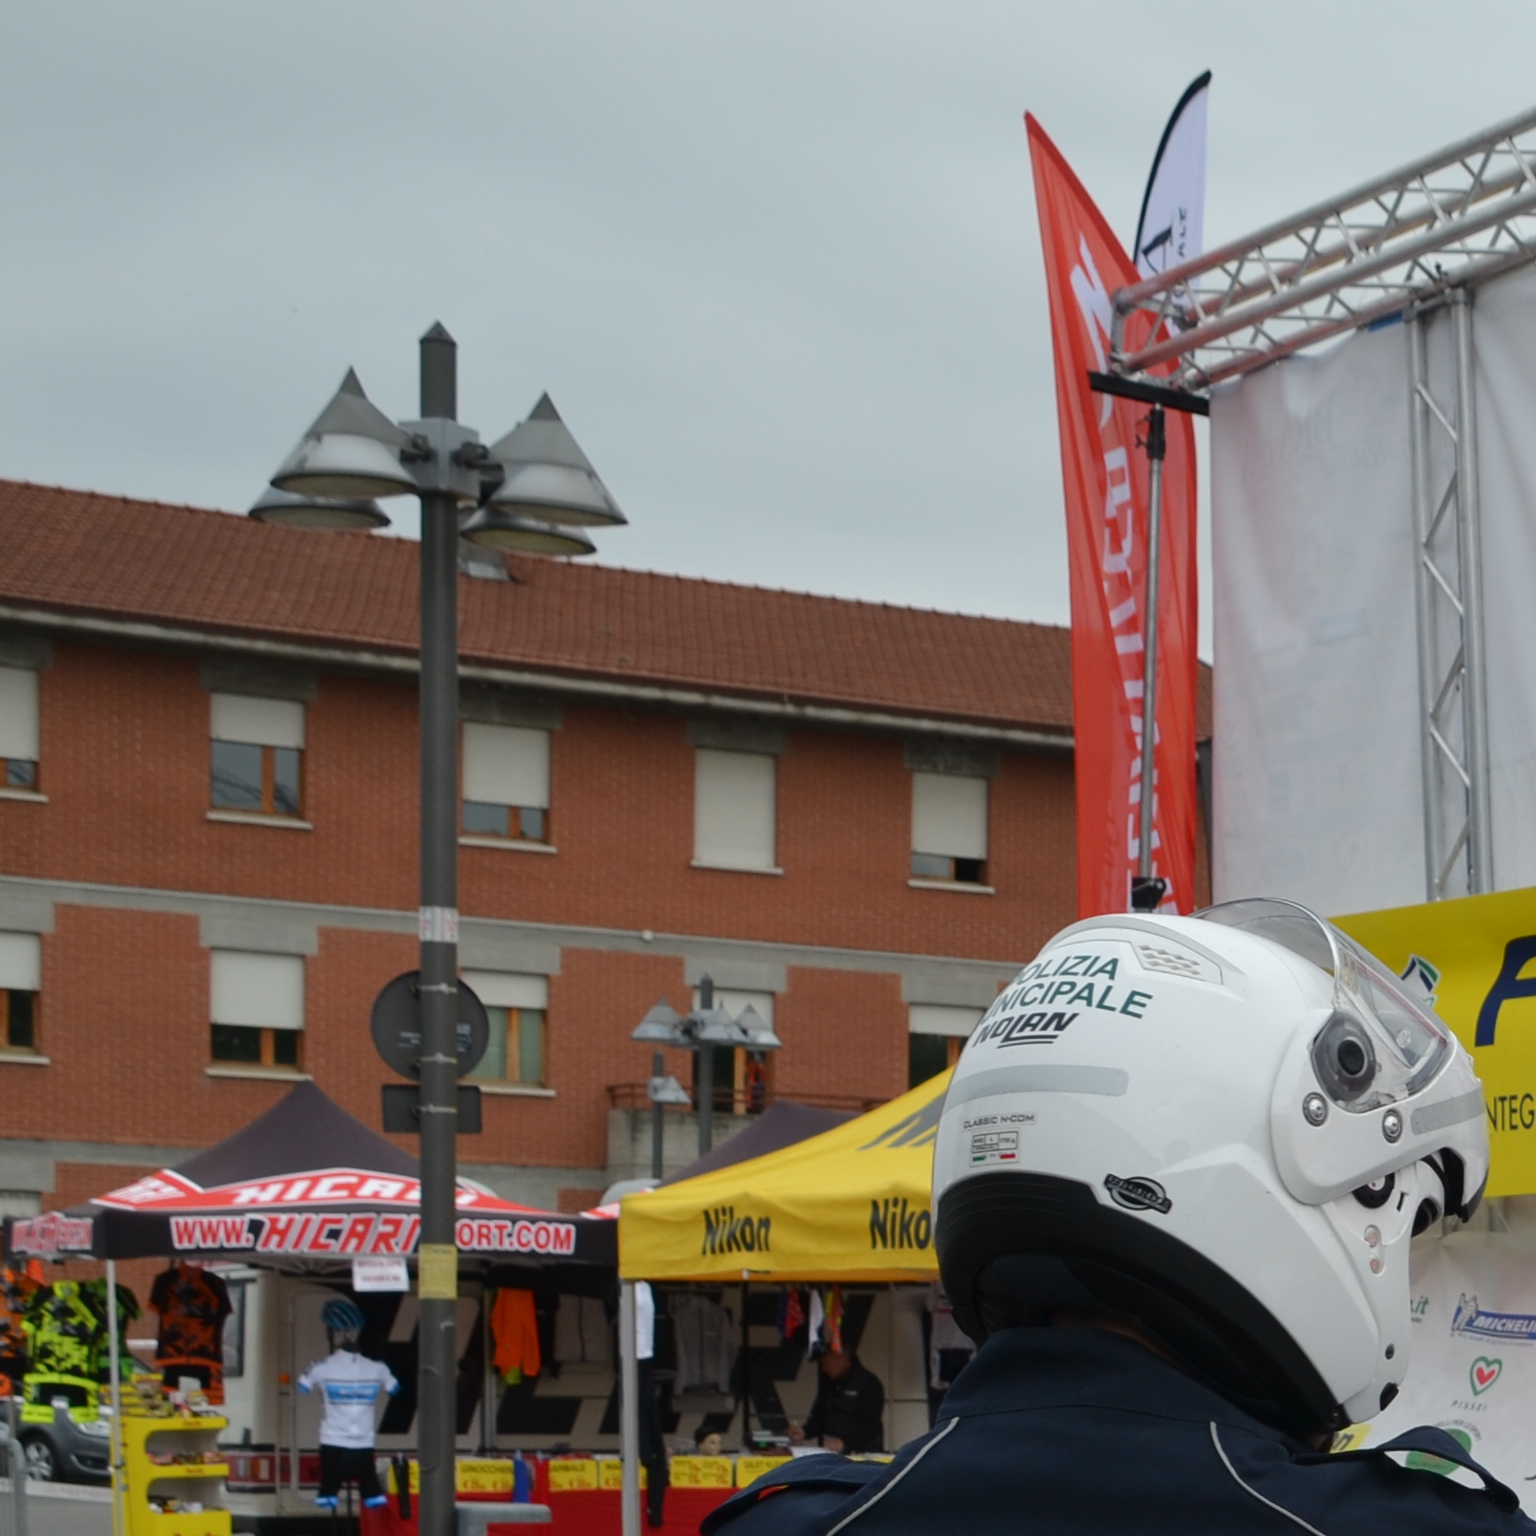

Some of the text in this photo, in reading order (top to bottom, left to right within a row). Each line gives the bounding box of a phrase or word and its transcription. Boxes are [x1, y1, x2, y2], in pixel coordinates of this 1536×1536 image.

[1012, 955, 1120, 986] OLIZIA
[972, 1011, 1081, 1049] NOLAN
[963, 1113, 1035, 1129] CLASSIC N-COM
[170, 1212, 577, 1256] WWW.HICARIORT.COM
[701, 1197, 935, 1256] Nikon Niko
